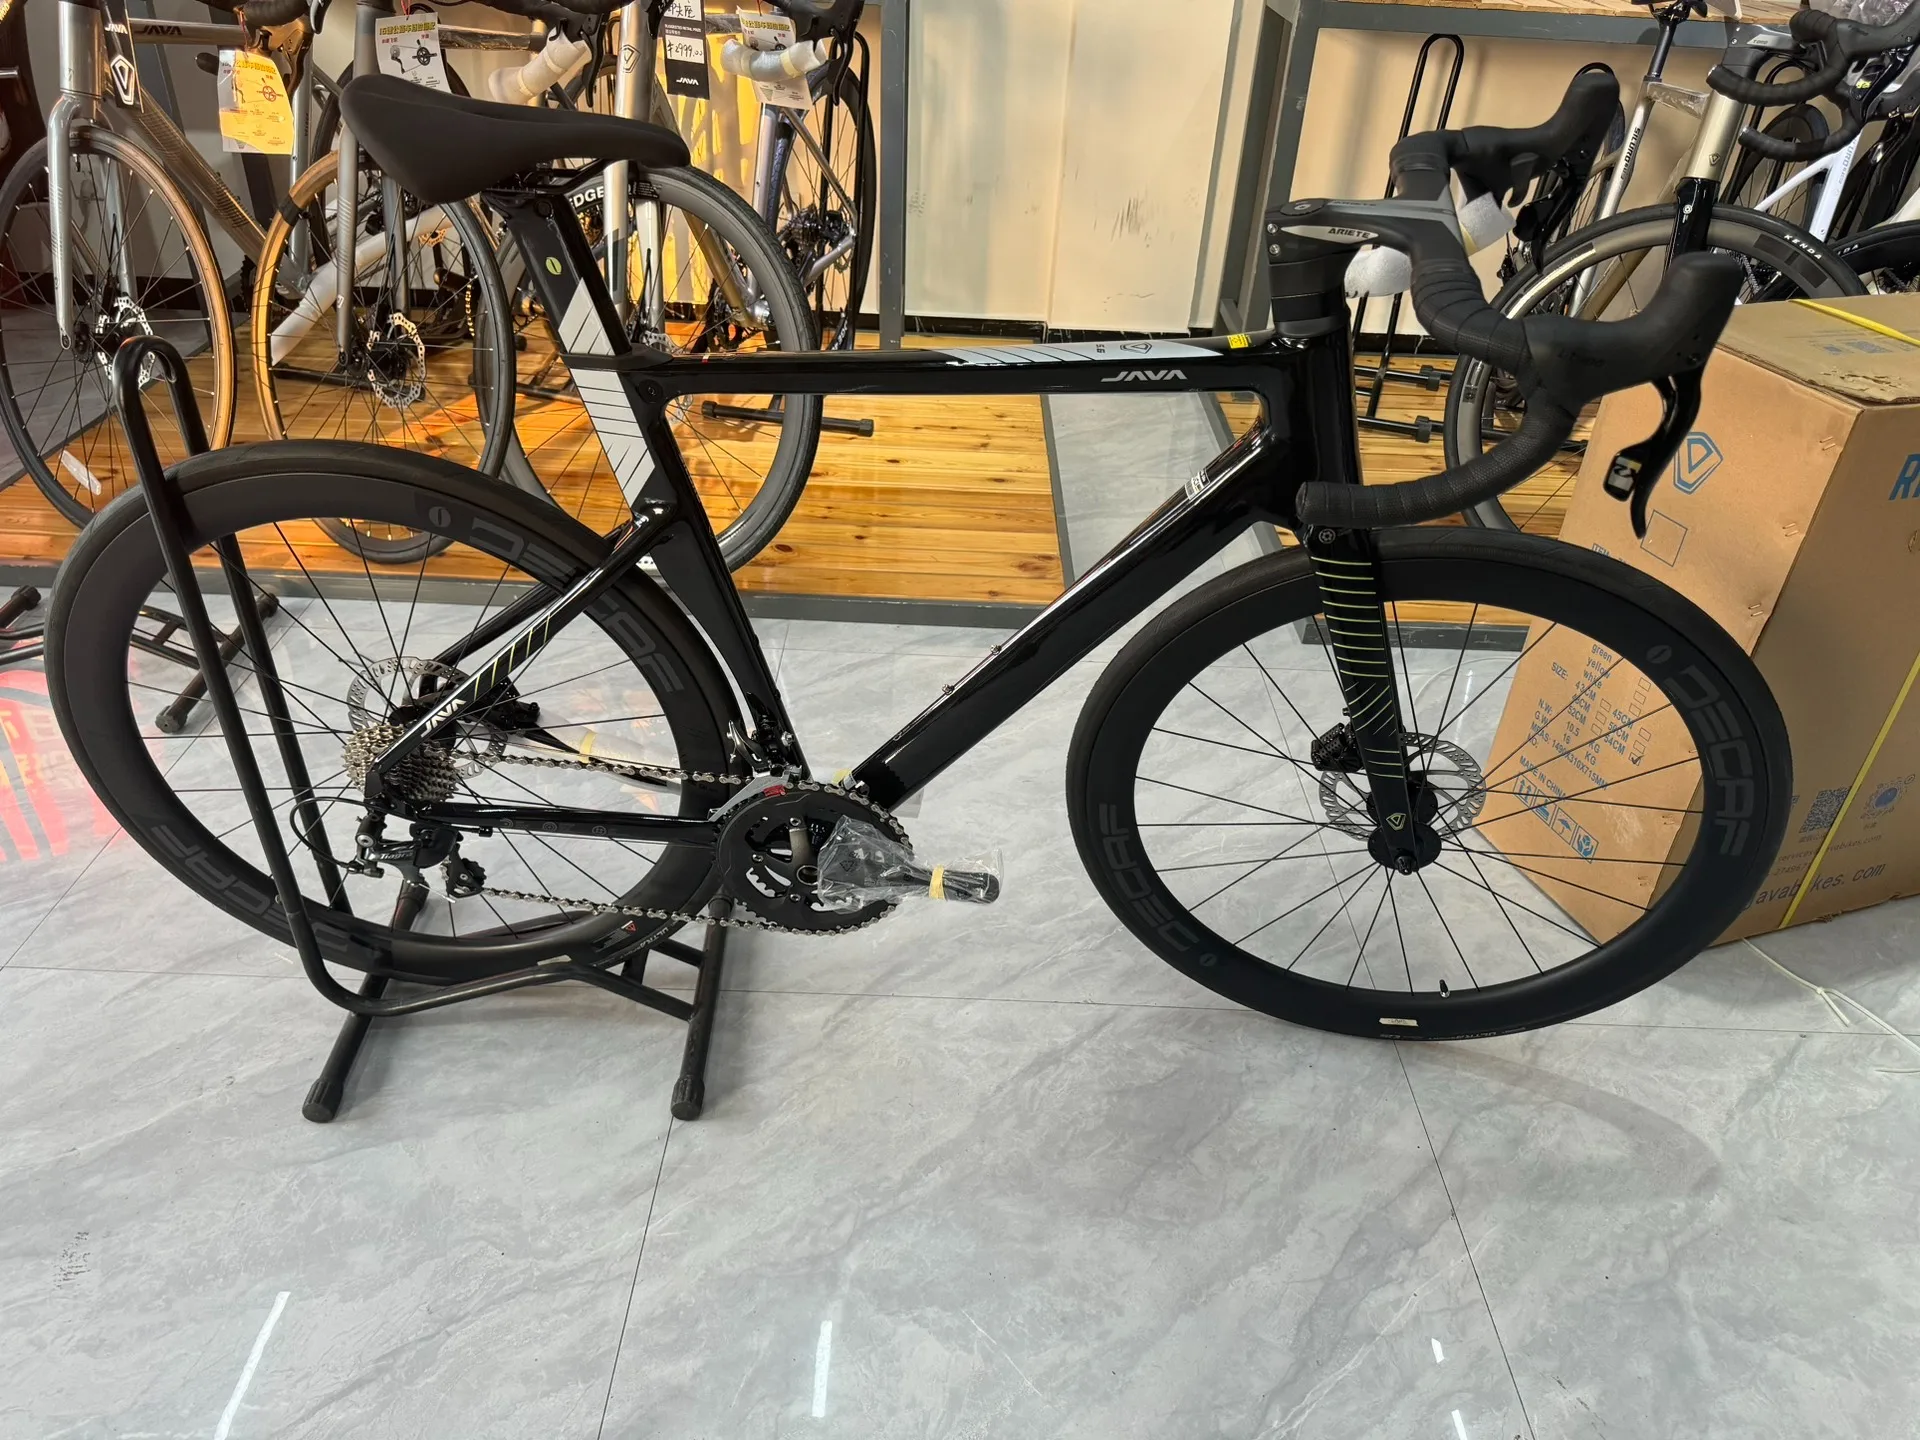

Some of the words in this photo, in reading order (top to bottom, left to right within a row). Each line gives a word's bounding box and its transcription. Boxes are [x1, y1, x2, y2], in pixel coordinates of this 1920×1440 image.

[104, 23, 128, 35] JAVA
[134, 25, 183, 35] JAVA
[676, 77, 699, 86] JAVA
[1624, 126, 1641, 164] SILURO
[1328, 228, 1370, 239] ARIETE
[1784, 234, 1823, 260] KENDA
[1100, 369, 1188, 383] JAVA
[1591, 643, 1613, 662] green
[1551, 661, 1569, 681] SIZE:
[1587, 656, 1611, 679] yellow
[420, 698, 467, 738] JAVA
[1612, 708, 1634, 730] 45CM
[1565, 721, 1581, 737] 10.5
[1588, 740, 1601, 754] KG
[1567, 705, 1587, 725] 52CM
[1604, 734, 1626, 755] 54CM
[1584, 751, 1597, 766] KG
[1663, 664, 1754, 855] DECAF
[1519, 755, 1539, 776] MADE
[1538, 771, 1548, 785] IN
[1100, 802, 1200, 952] DECAF
[640, 926, 669, 948] ULTRA
